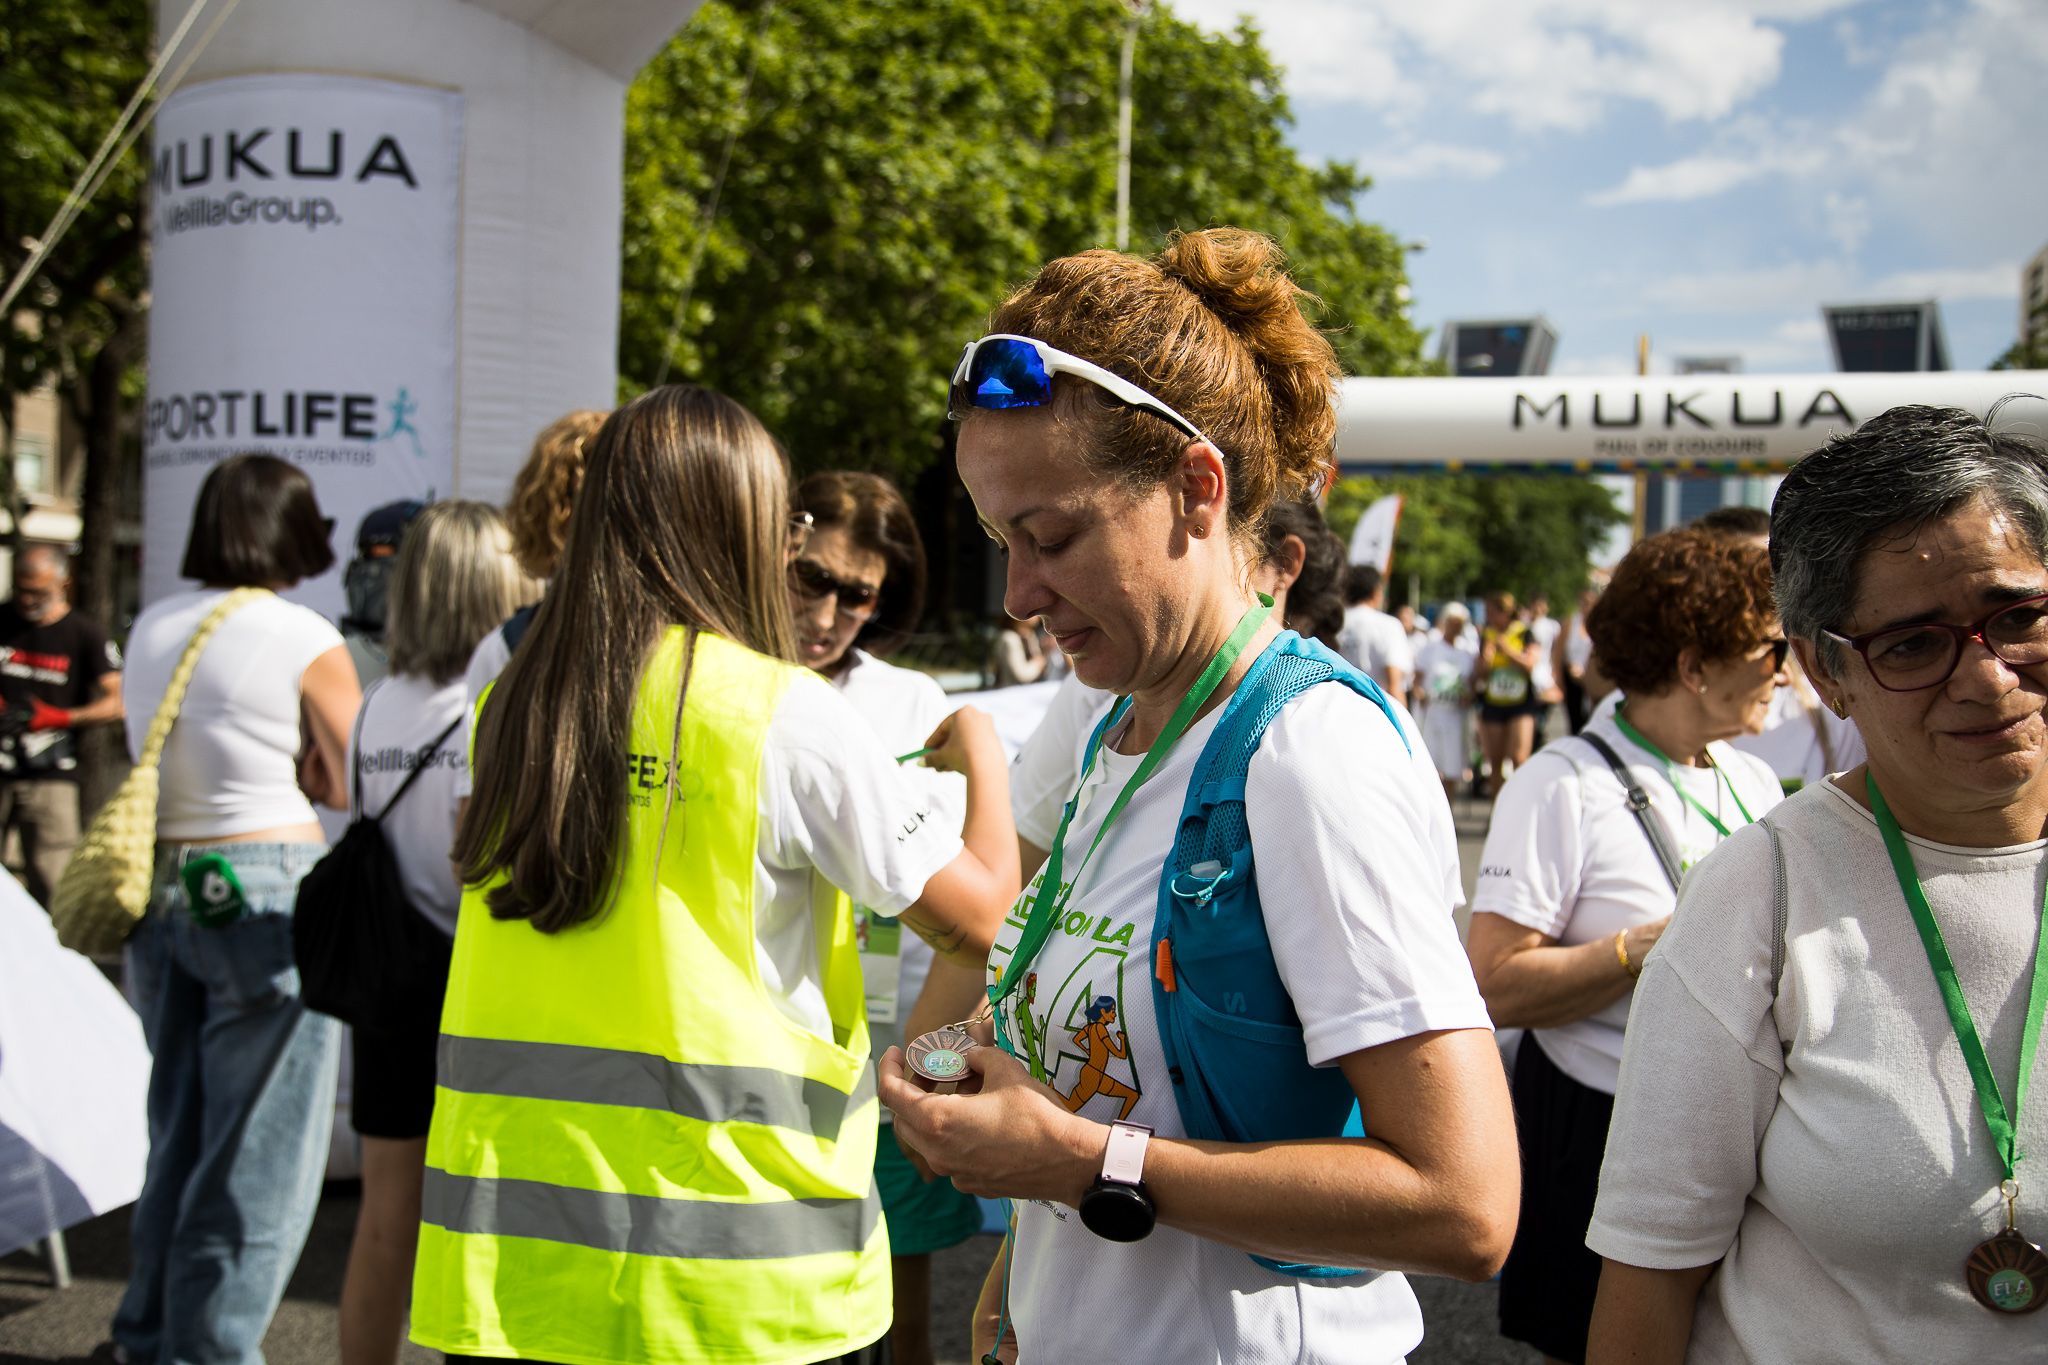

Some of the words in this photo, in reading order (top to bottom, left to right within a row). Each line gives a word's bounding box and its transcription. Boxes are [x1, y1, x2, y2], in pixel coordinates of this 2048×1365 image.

[147, 389, 377, 446] PORTLIFE
[1513, 388, 1856, 431] MUKUA
[1594, 437, 1637, 455] FULL
[1643, 437, 1668, 455] OF
[1672, 436, 1768, 455] COLOURS
[1091, 915, 1136, 947] LA
